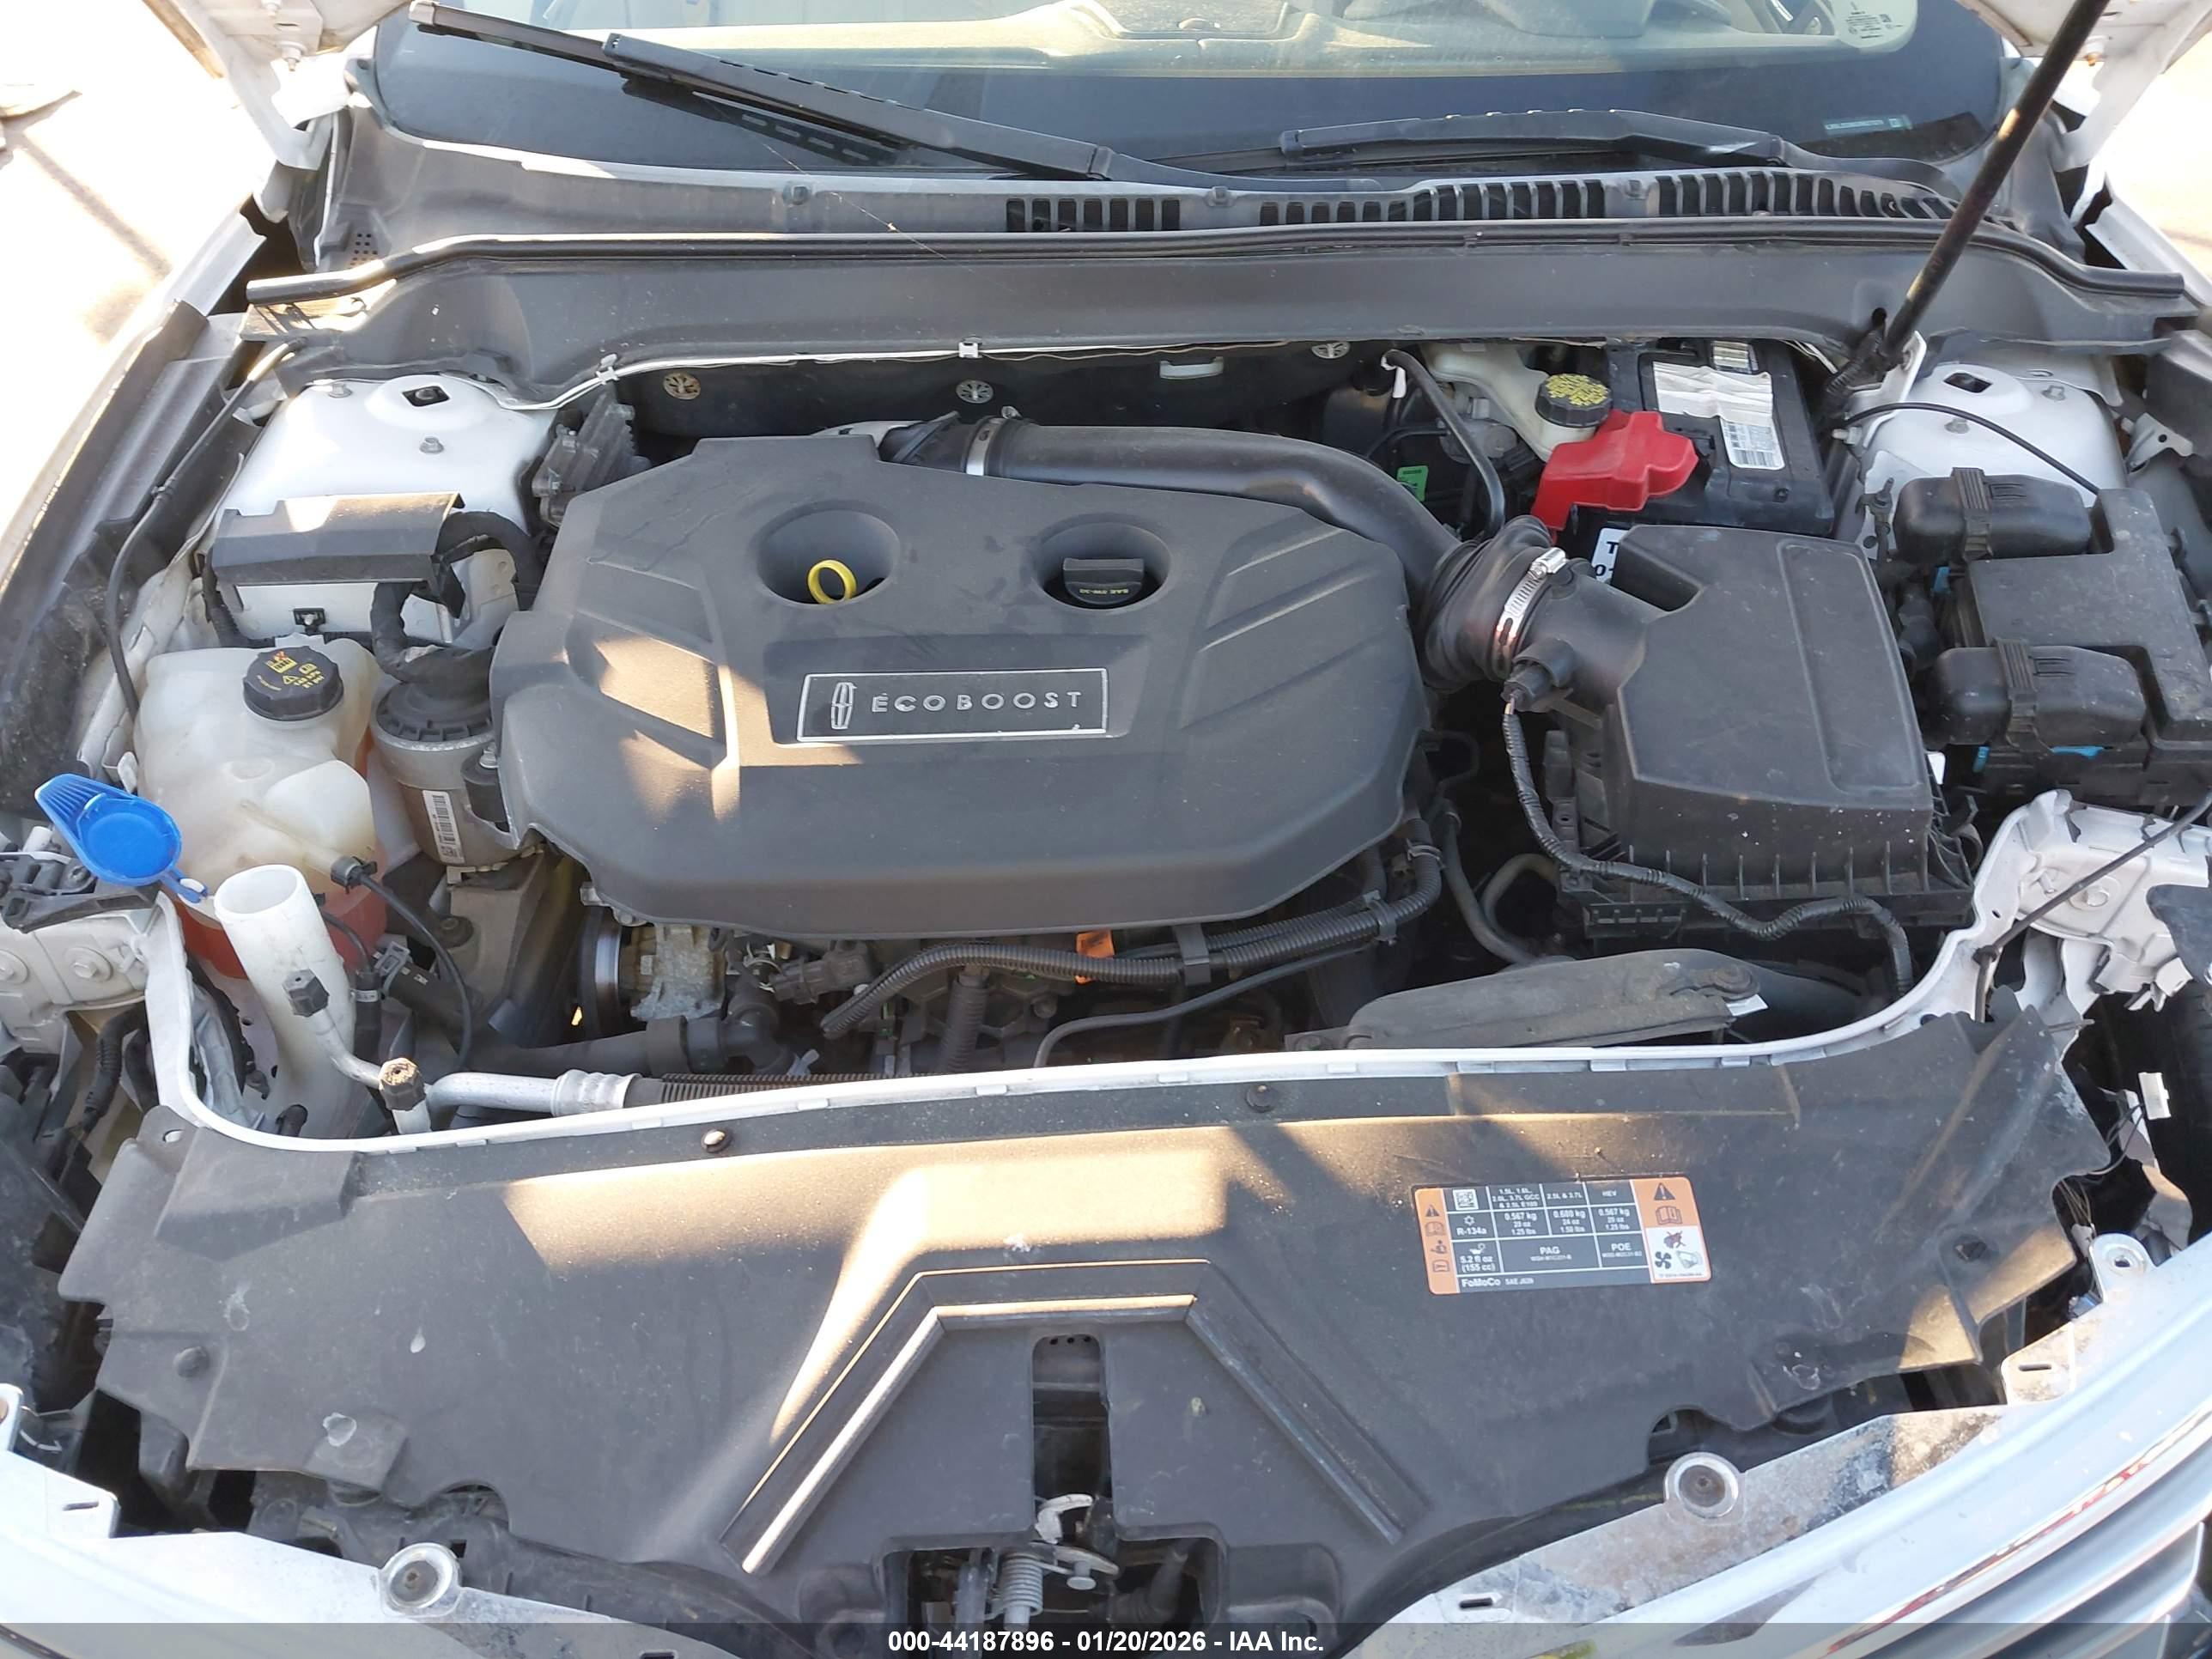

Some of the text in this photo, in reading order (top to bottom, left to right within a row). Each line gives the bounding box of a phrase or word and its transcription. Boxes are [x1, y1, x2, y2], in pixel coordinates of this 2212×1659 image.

[872, 691, 1081, 713] ECOBOOST
[1525, 1212, 1537, 1221] kg
[1574, 1209, 1586, 1219] kg
[1619, 1207, 1631, 1217] kg
[1456, 1226, 1487, 1236] R-134a
[1539, 1246, 1560, 1255] PAG
[1611, 1242, 1632, 1251] POE
[1460, 1255, 1473, 1264] 5.2
[1462, 1262, 1496, 1273] (155 cc)
[1462, 1277, 1501, 1287] FoMoCo
